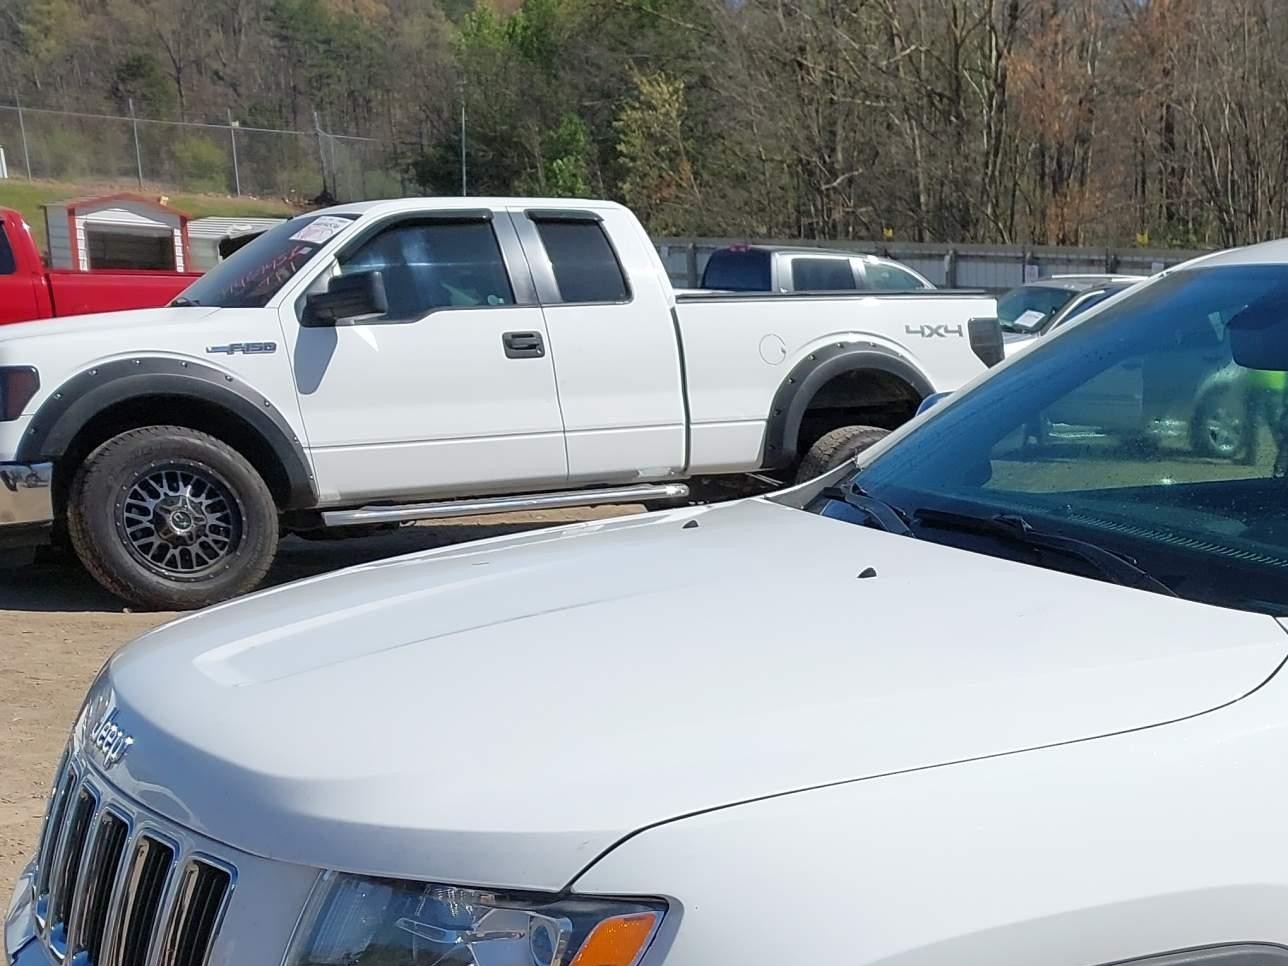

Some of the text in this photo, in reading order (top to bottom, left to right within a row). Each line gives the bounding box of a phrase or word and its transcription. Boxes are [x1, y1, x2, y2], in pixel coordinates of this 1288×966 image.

[904, 324, 964, 338] 4X4
[227, 341, 277, 356] F-150
[91, 708, 134, 771] Jeep
